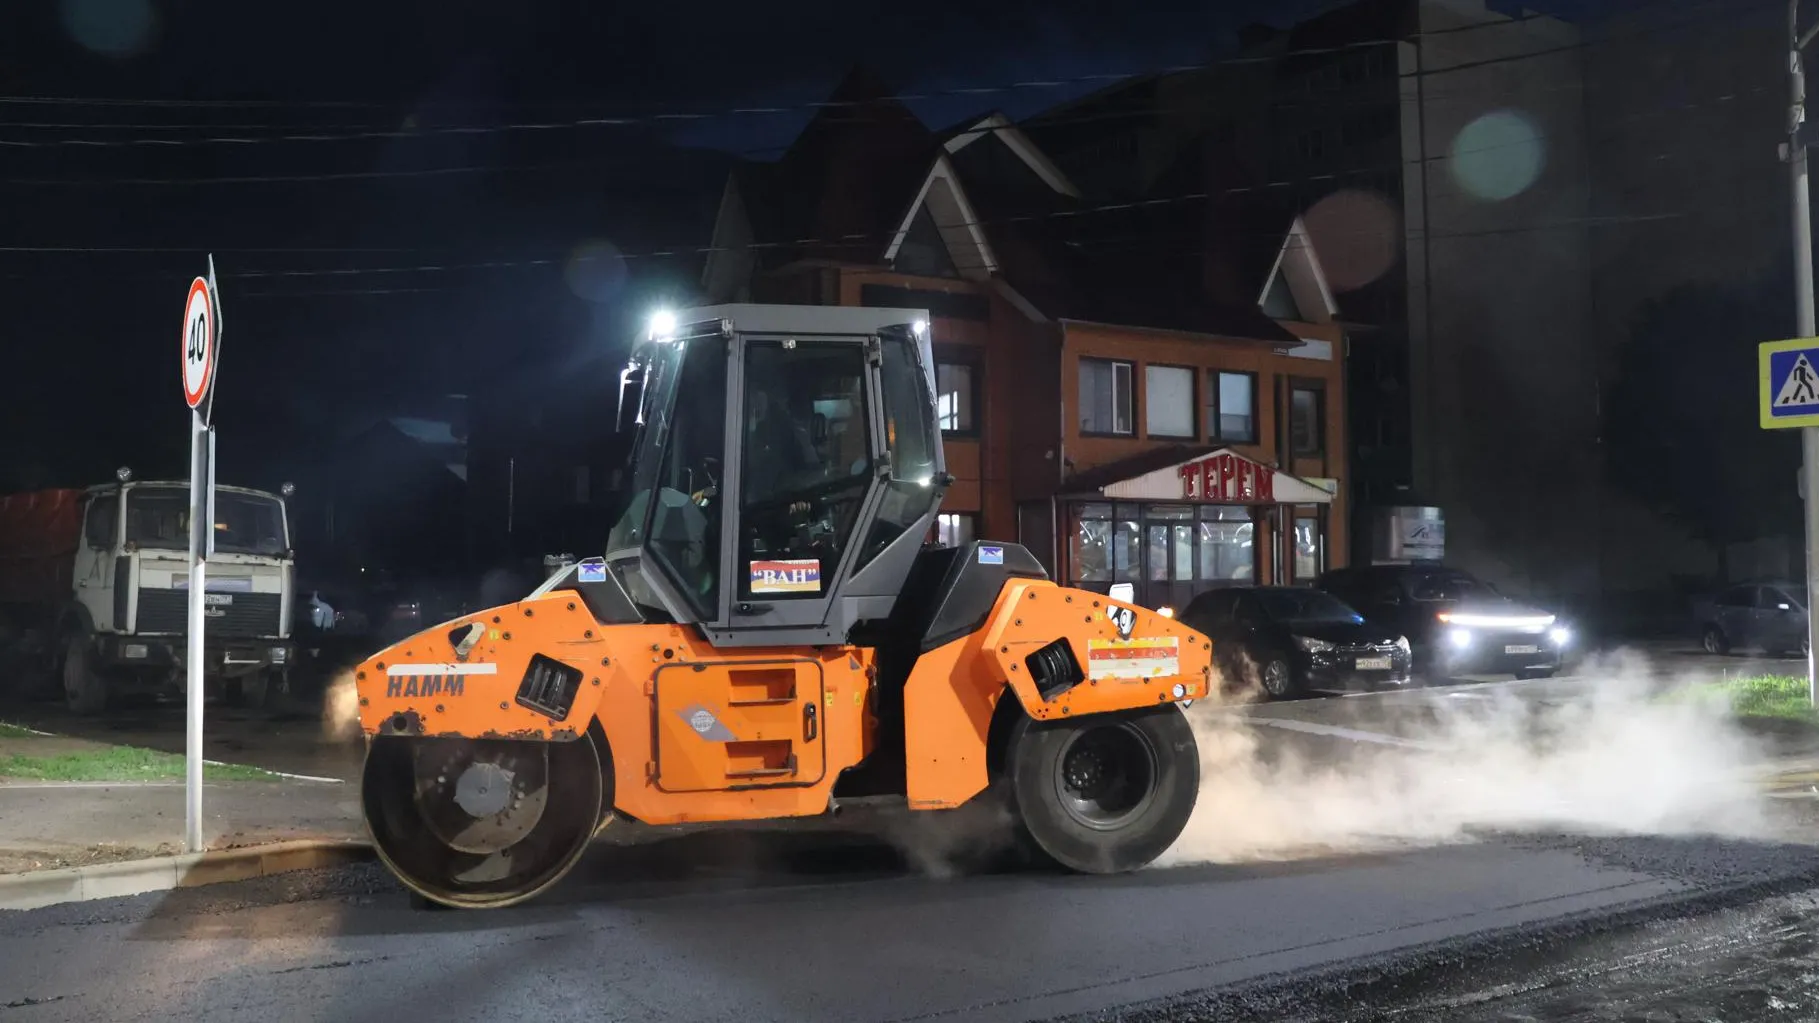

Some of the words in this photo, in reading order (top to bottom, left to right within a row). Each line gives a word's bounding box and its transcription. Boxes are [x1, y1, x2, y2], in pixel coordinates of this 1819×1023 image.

[188, 313, 206, 365] 40
[1178, 454, 1277, 504] ТЕРЕМ
[386, 674, 465, 698] HAMM
